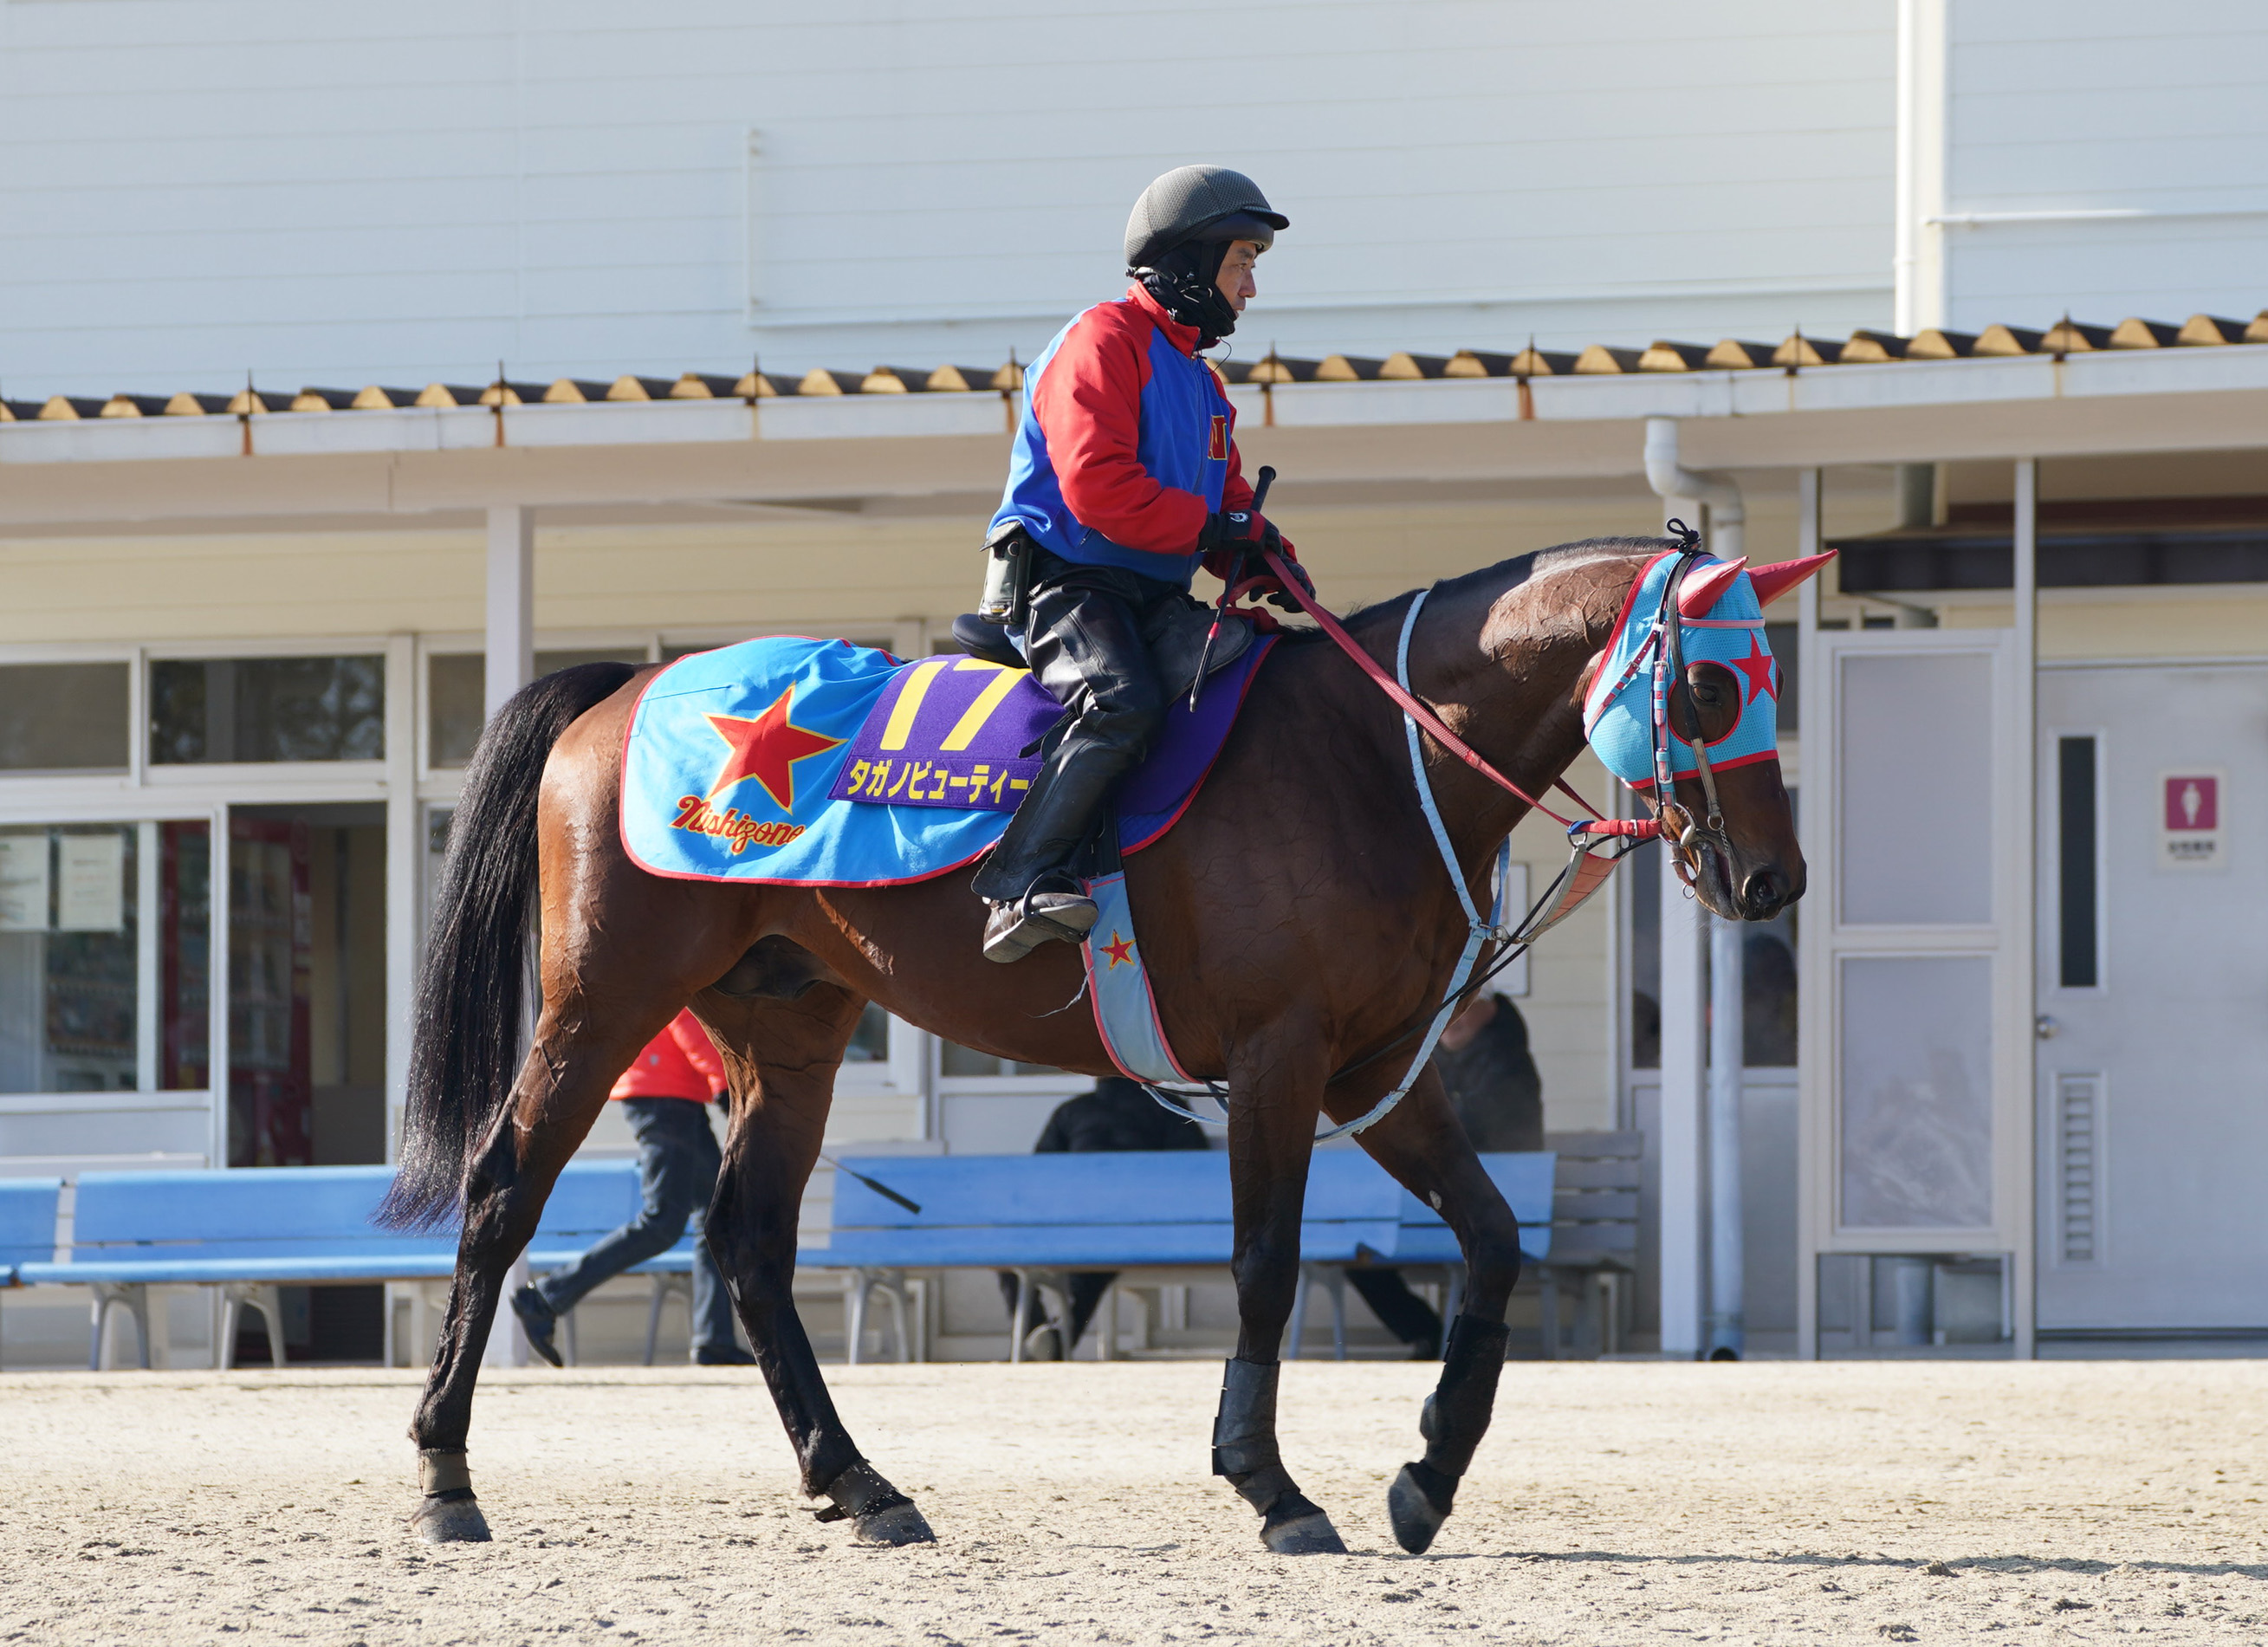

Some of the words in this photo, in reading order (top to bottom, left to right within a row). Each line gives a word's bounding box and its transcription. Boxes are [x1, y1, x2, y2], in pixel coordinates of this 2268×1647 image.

[879, 658, 1032, 750] 17
[846, 759, 1029, 804] タガノビューティー
